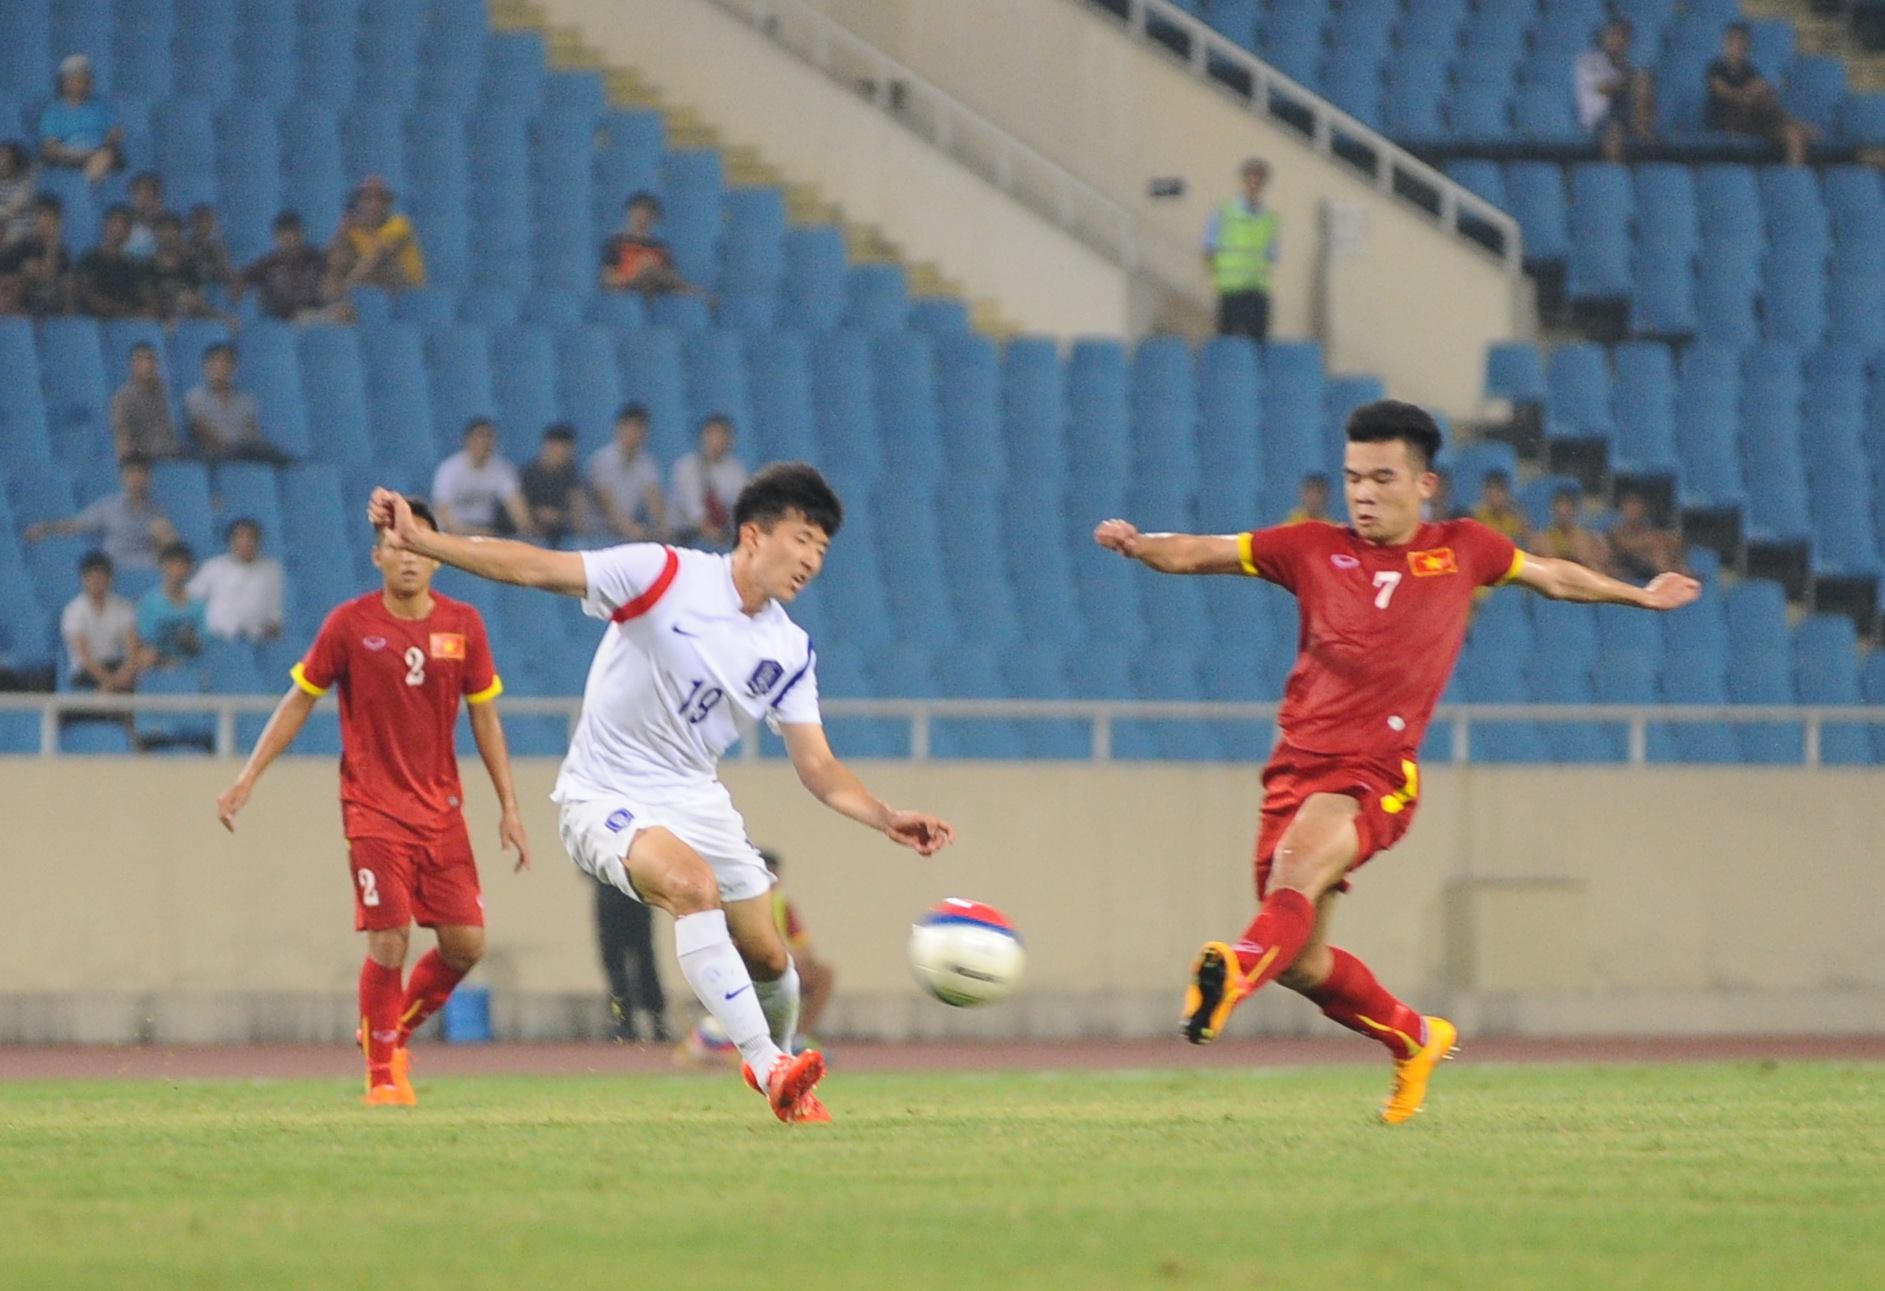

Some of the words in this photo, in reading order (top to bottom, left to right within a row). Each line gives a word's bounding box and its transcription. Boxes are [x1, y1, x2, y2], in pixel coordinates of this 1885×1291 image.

[1372, 571, 1402, 609] 7
[404, 646, 425, 686] 2
[678, 679, 723, 724] 19
[357, 868, 380, 907] 2
